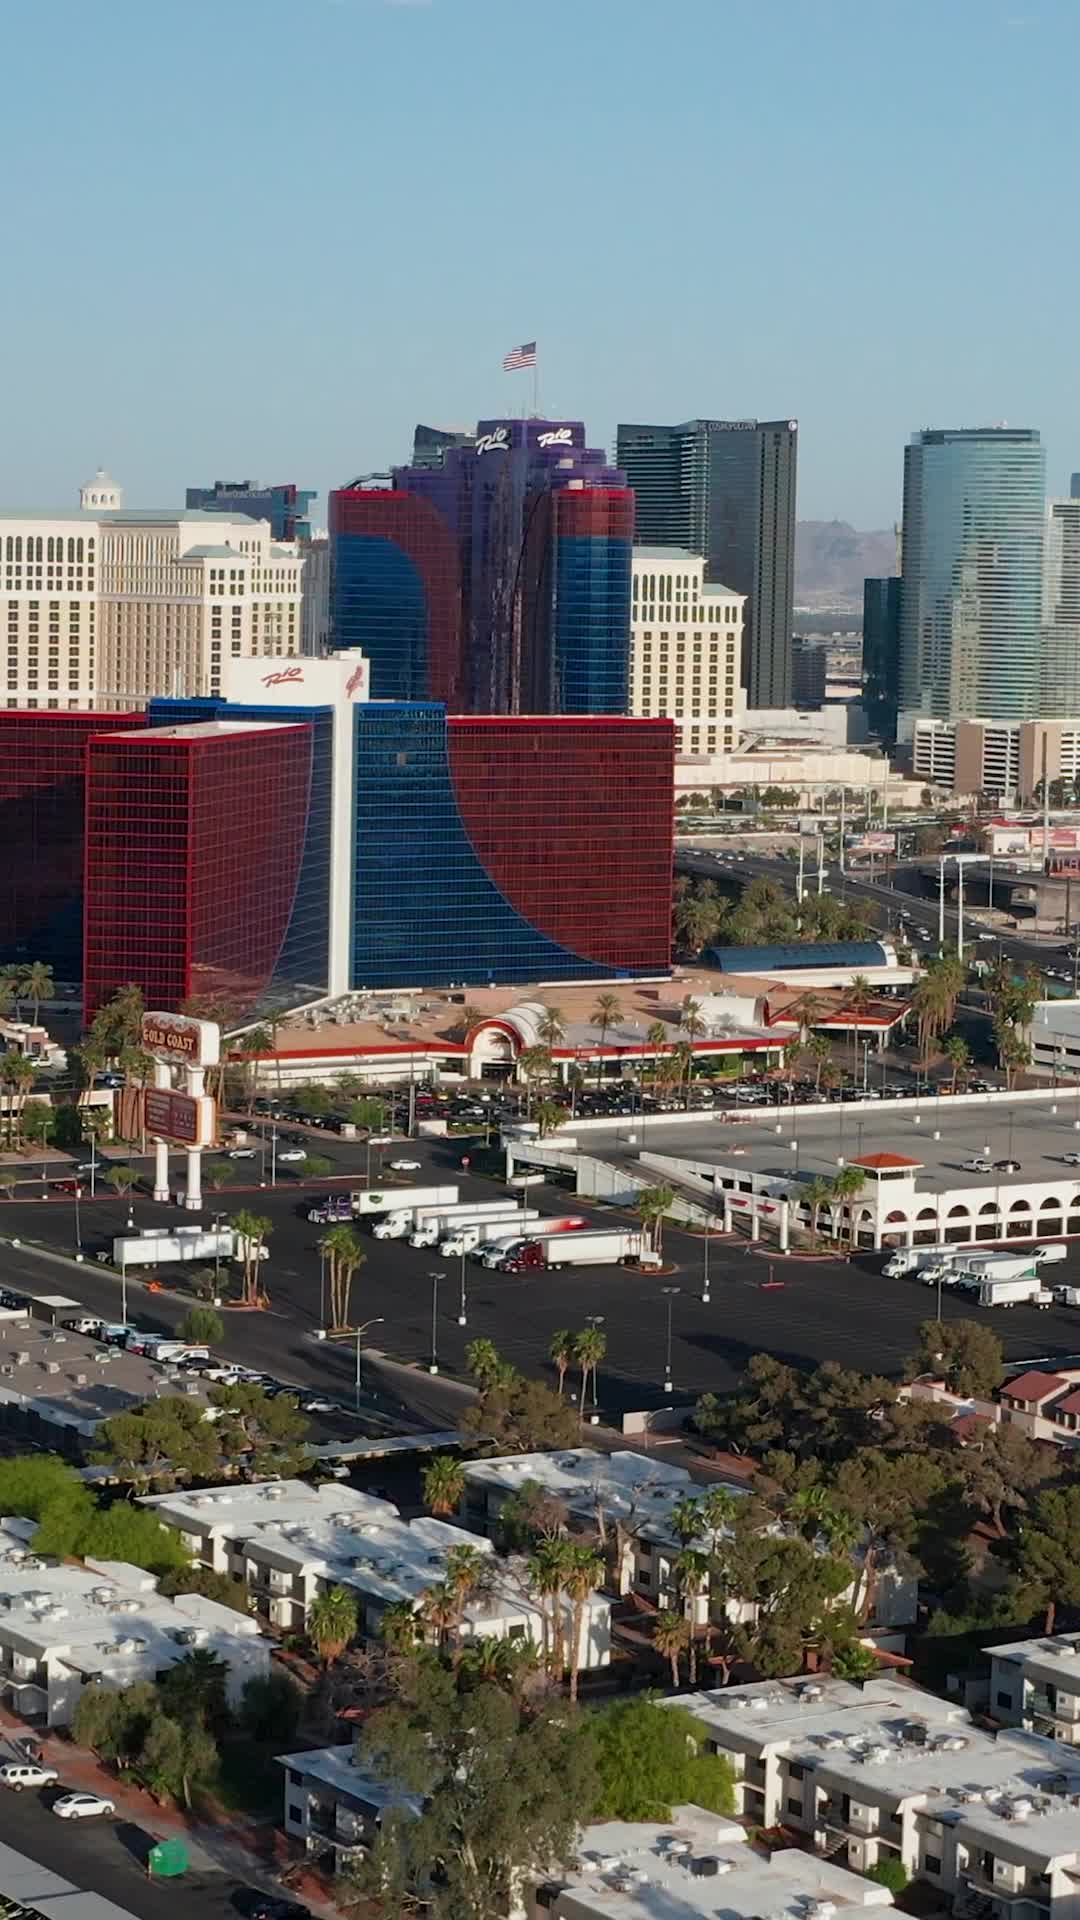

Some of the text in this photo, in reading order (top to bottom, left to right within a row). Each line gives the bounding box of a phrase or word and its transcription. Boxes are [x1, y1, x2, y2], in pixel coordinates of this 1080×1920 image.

[475, 427, 509, 456] Rio
[537, 427, 573, 448] Rio
[261, 666, 304, 688] Rio
[143, 1028, 194, 1051] GOLD COAST
